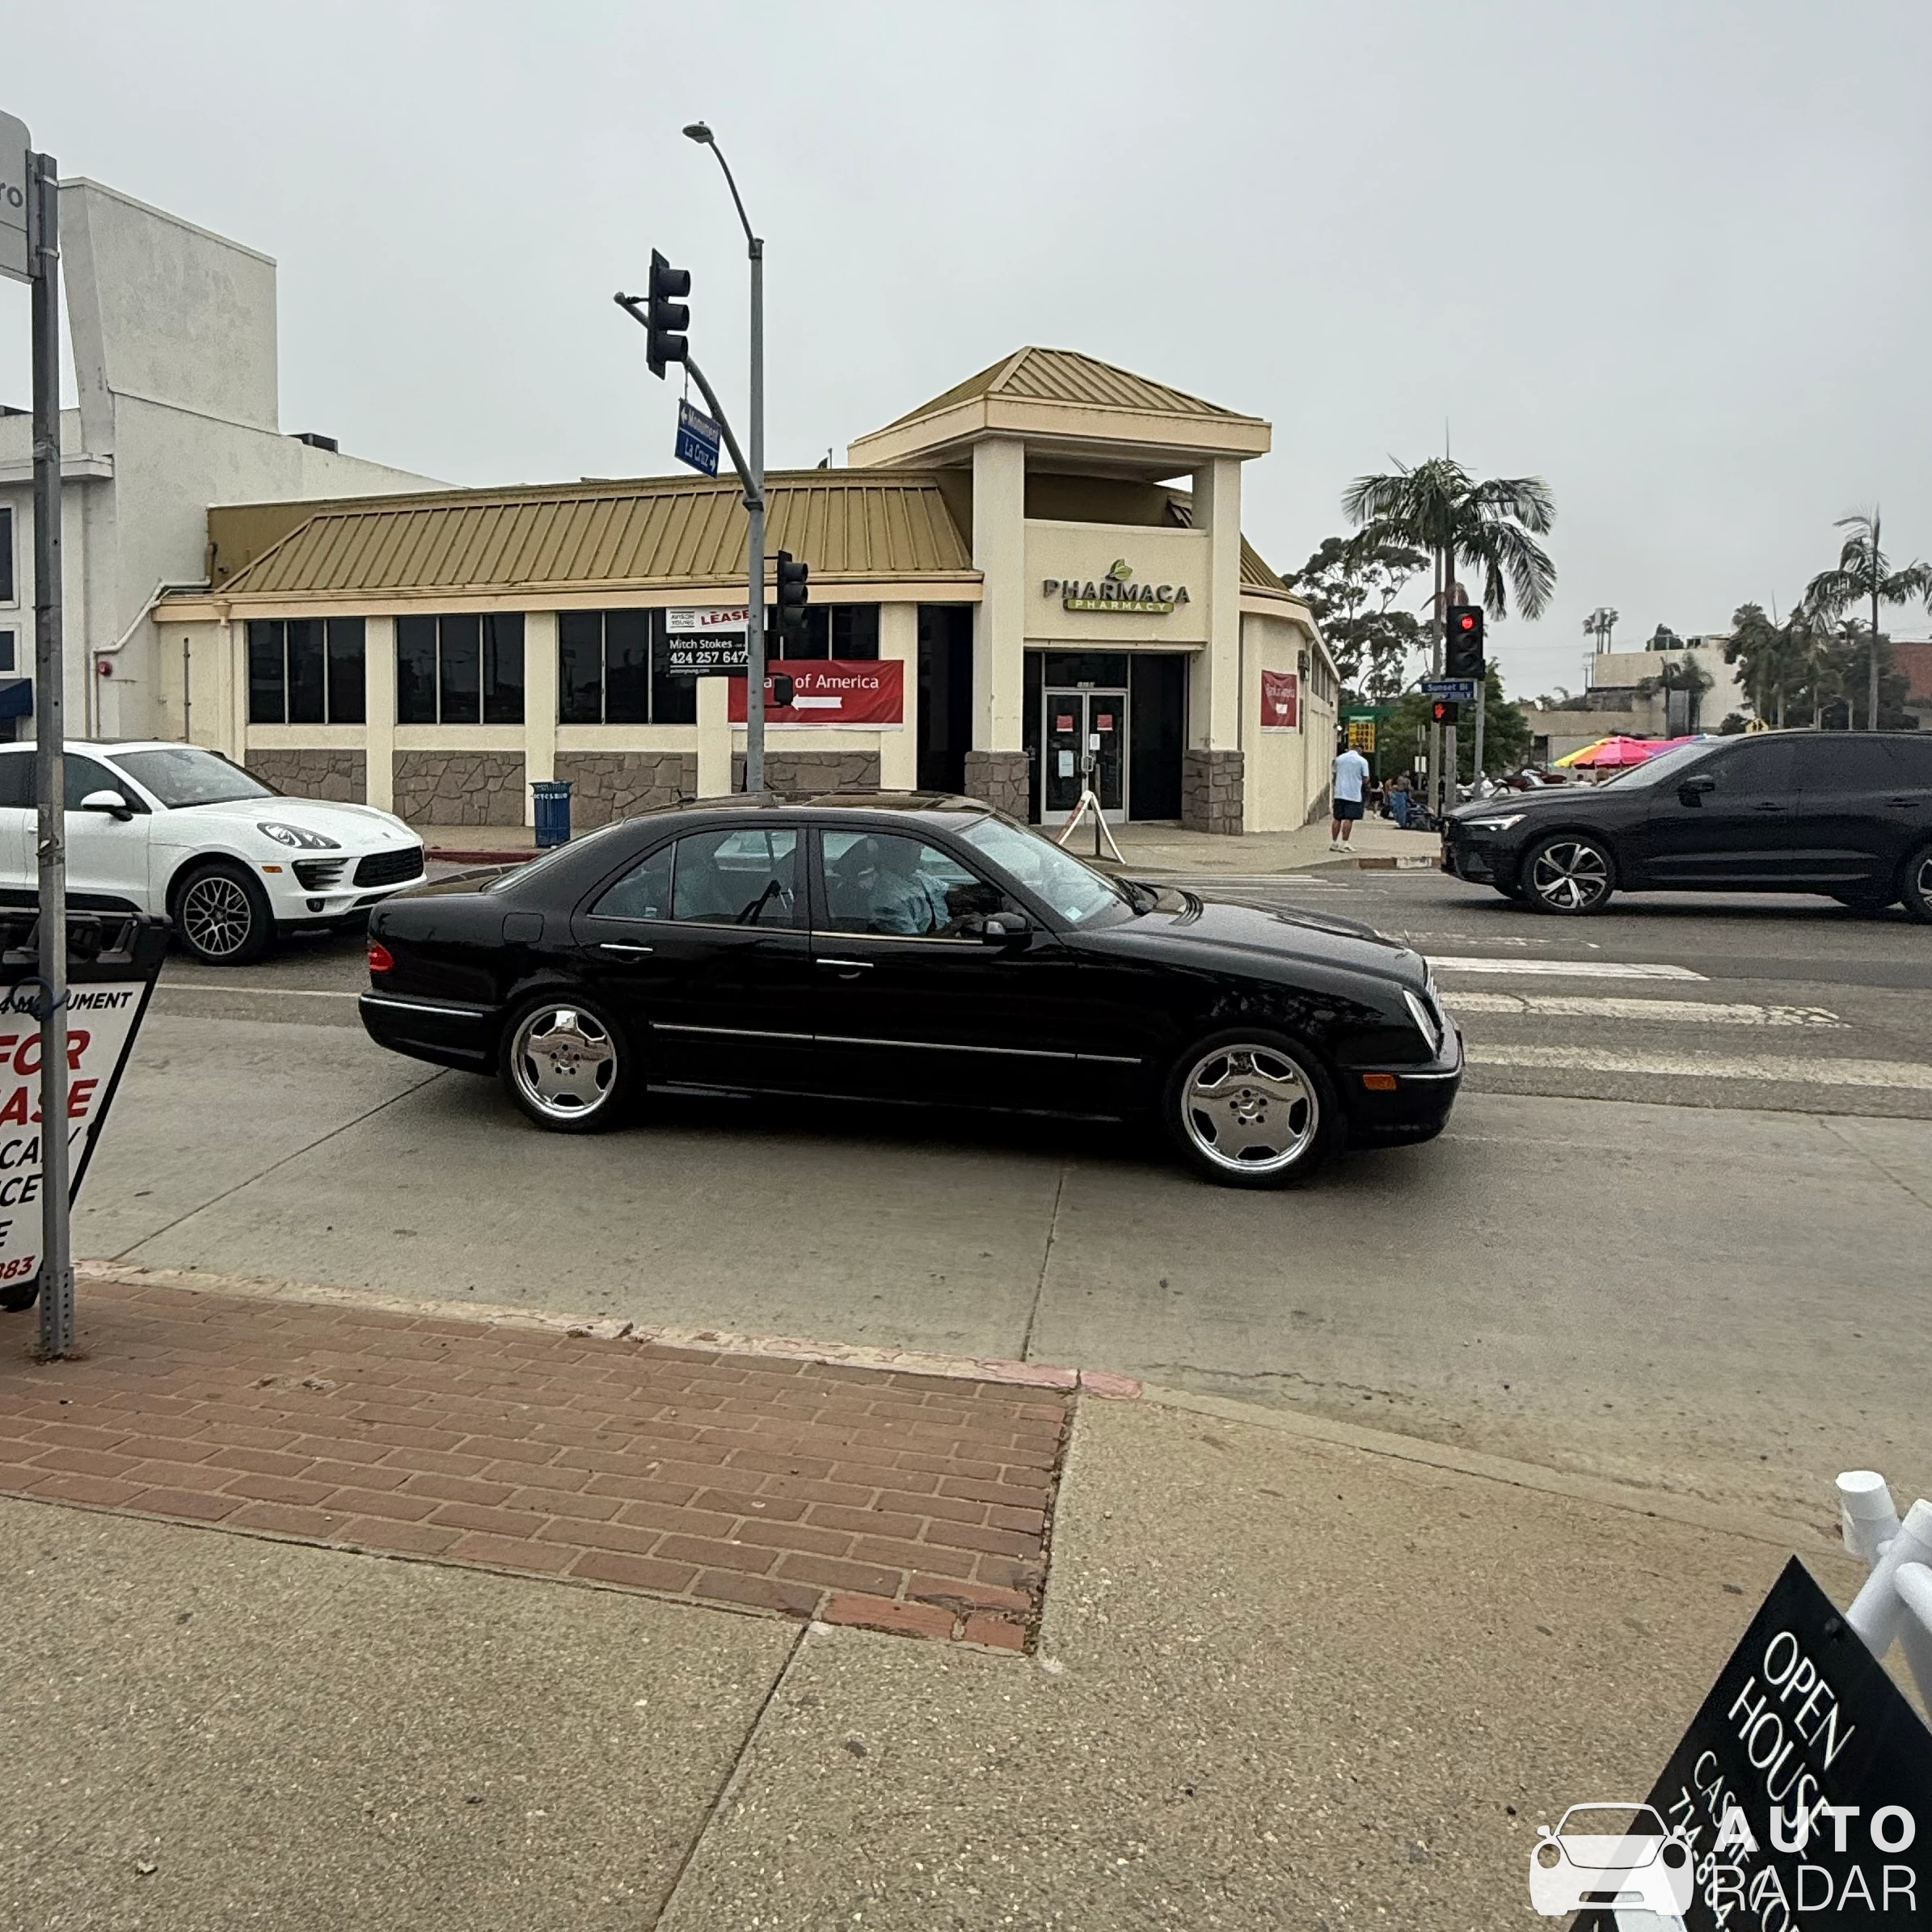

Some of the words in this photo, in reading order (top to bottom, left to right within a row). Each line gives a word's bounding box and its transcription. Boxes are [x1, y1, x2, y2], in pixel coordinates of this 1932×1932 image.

[685, 437, 694, 458] La
[695, 444, 710, 468] Cruz
[1043, 580, 1190, 603] PHARMACA
[1075, 600, 1166, 611] PHARMACY
[701, 610, 749, 626] LEASE
[669, 639, 698, 649] Mitch
[699, 639, 732, 649] Stokes
[670, 652, 693, 664] 424
[696, 652, 719, 664] 257
[723, 650, 749, 664] 647
[795, 673, 812, 689] of
[816, 674, 880, 689] America
[15, 991, 133, 1015] MUMENT
[1764, 1631, 1855, 1770] OPEN
[1727, 1676, 1836, 1860] HOUSE
